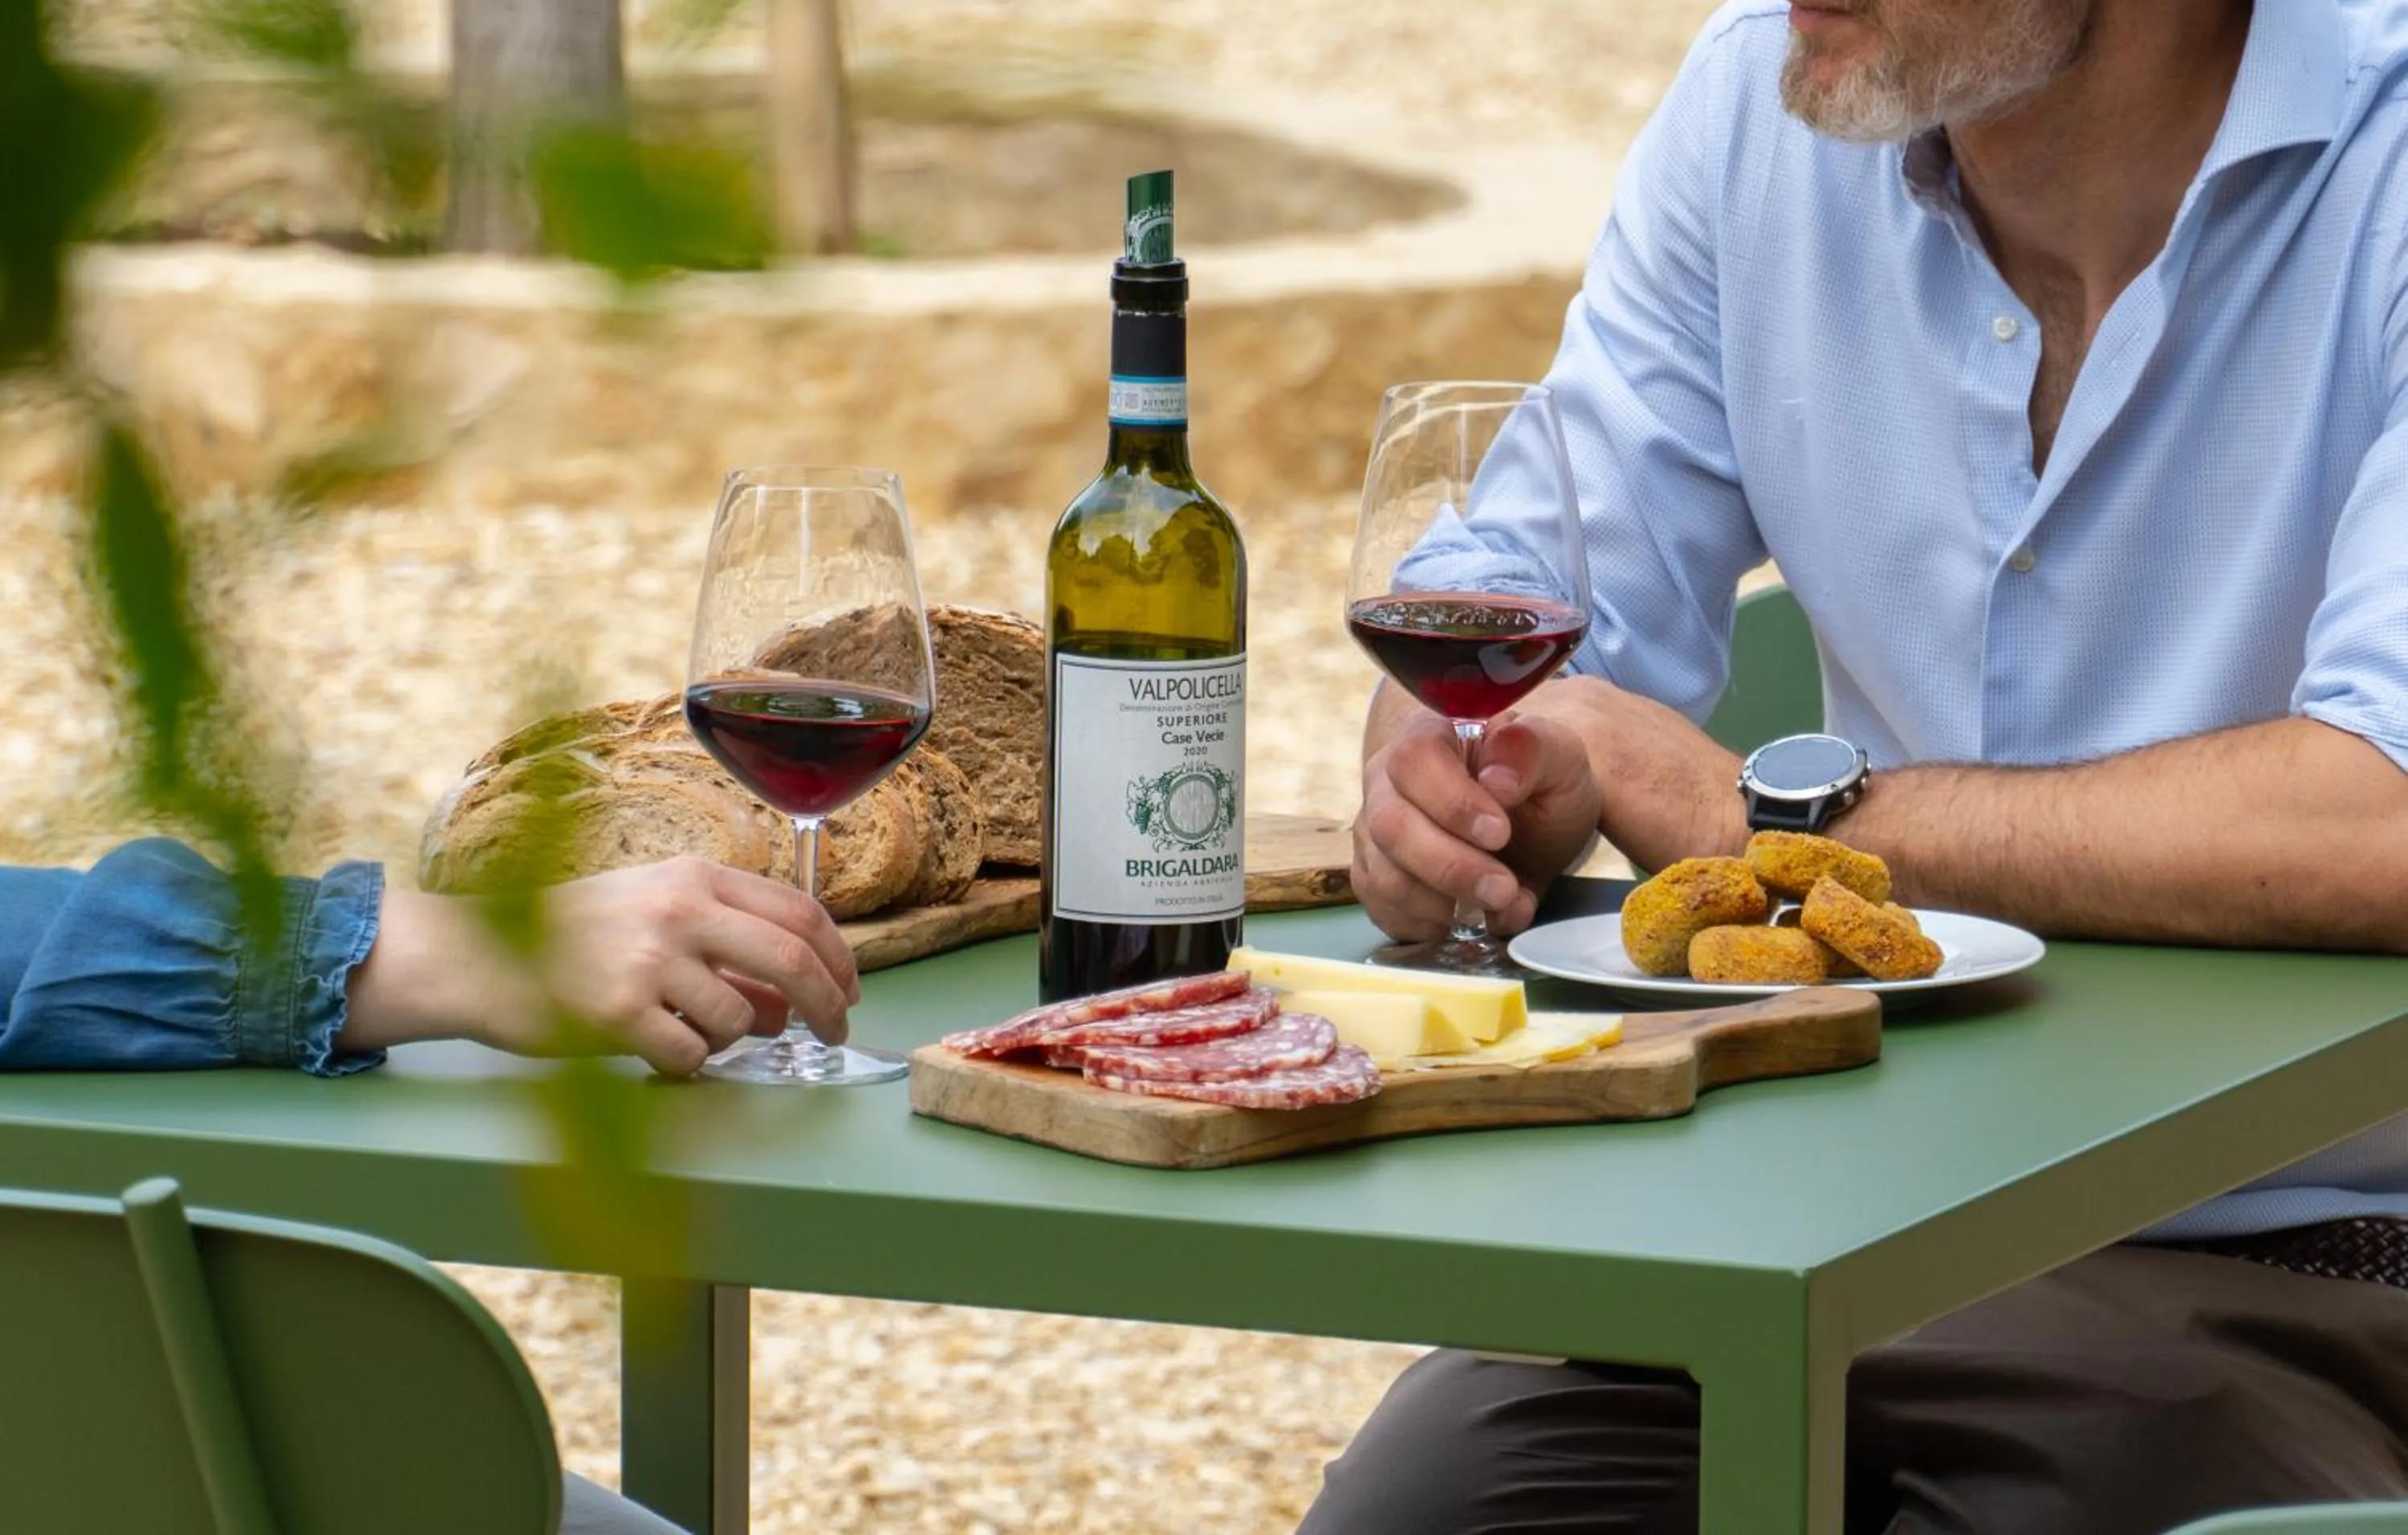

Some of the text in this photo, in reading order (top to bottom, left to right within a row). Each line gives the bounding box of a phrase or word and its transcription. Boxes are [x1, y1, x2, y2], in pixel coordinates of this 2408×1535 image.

[1129, 673, 1242, 701] VALPOLICELLA
[1157, 712, 1228, 727] SUPERIORE
[1161, 729, 1224, 744] Case Vecie
[1183, 746, 1208, 756] 2020
[1125, 853, 1239, 877] BRIGALDARA
